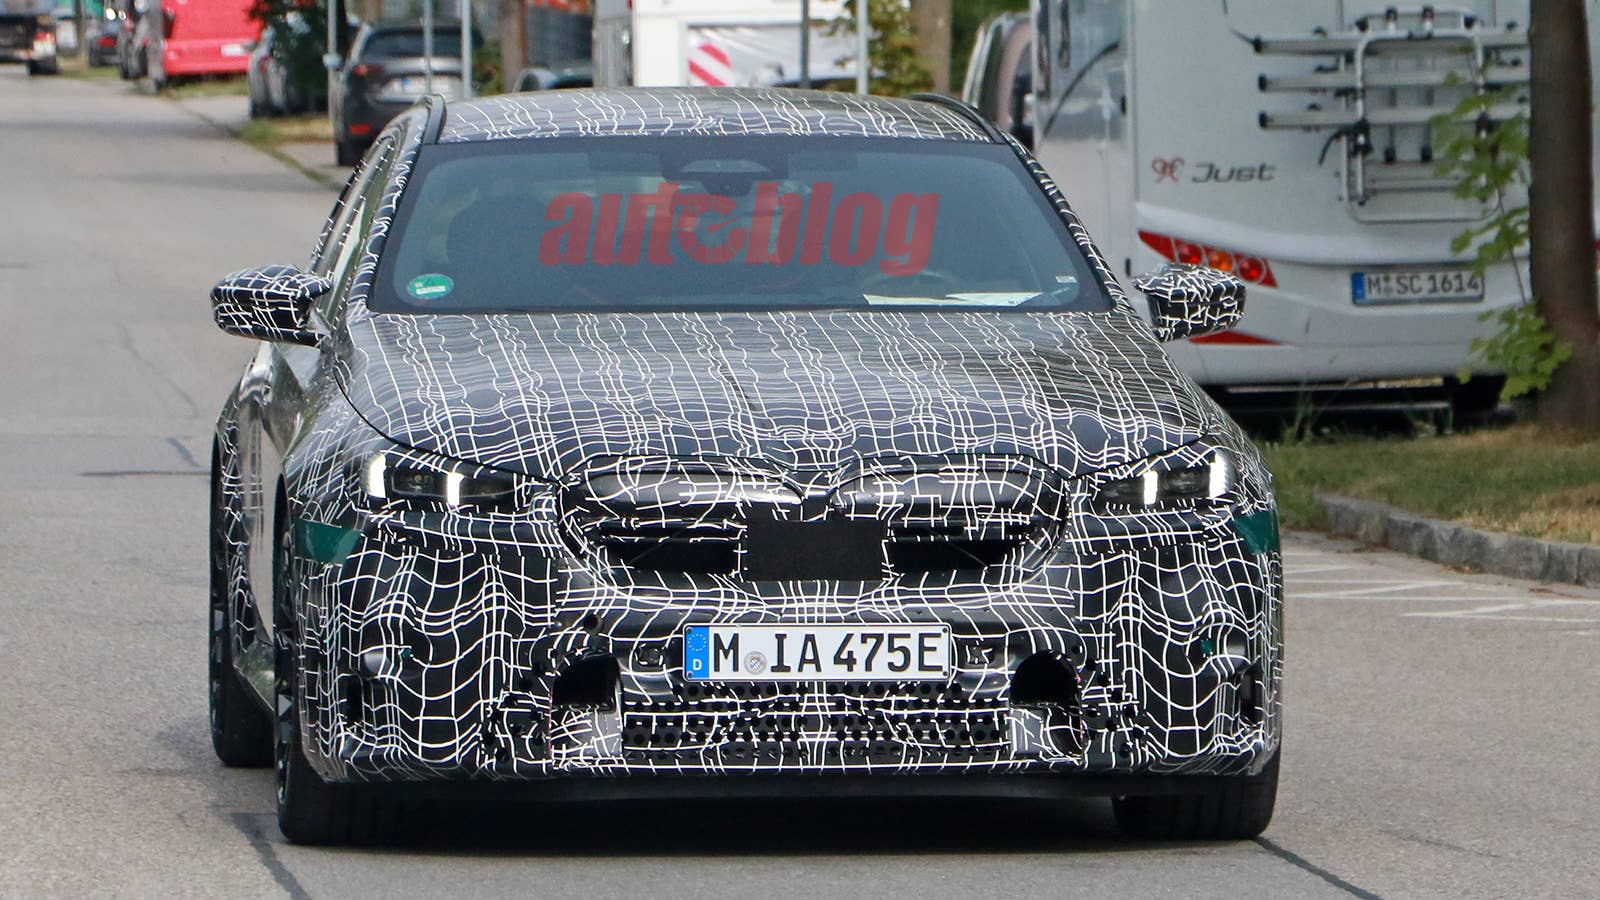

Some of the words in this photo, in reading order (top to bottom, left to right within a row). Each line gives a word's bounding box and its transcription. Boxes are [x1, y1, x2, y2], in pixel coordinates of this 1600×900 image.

[1192, 162, 1276, 183] Just
[1367, 277, 1382, 295] M
[1396, 275, 1422, 295] SC
[1428, 273, 1479, 294] 1614
[713, 633, 739, 672] M
[770, 633, 822, 672] IA
[833, 633, 943, 672] 475E
[692, 658, 703, 671] D
